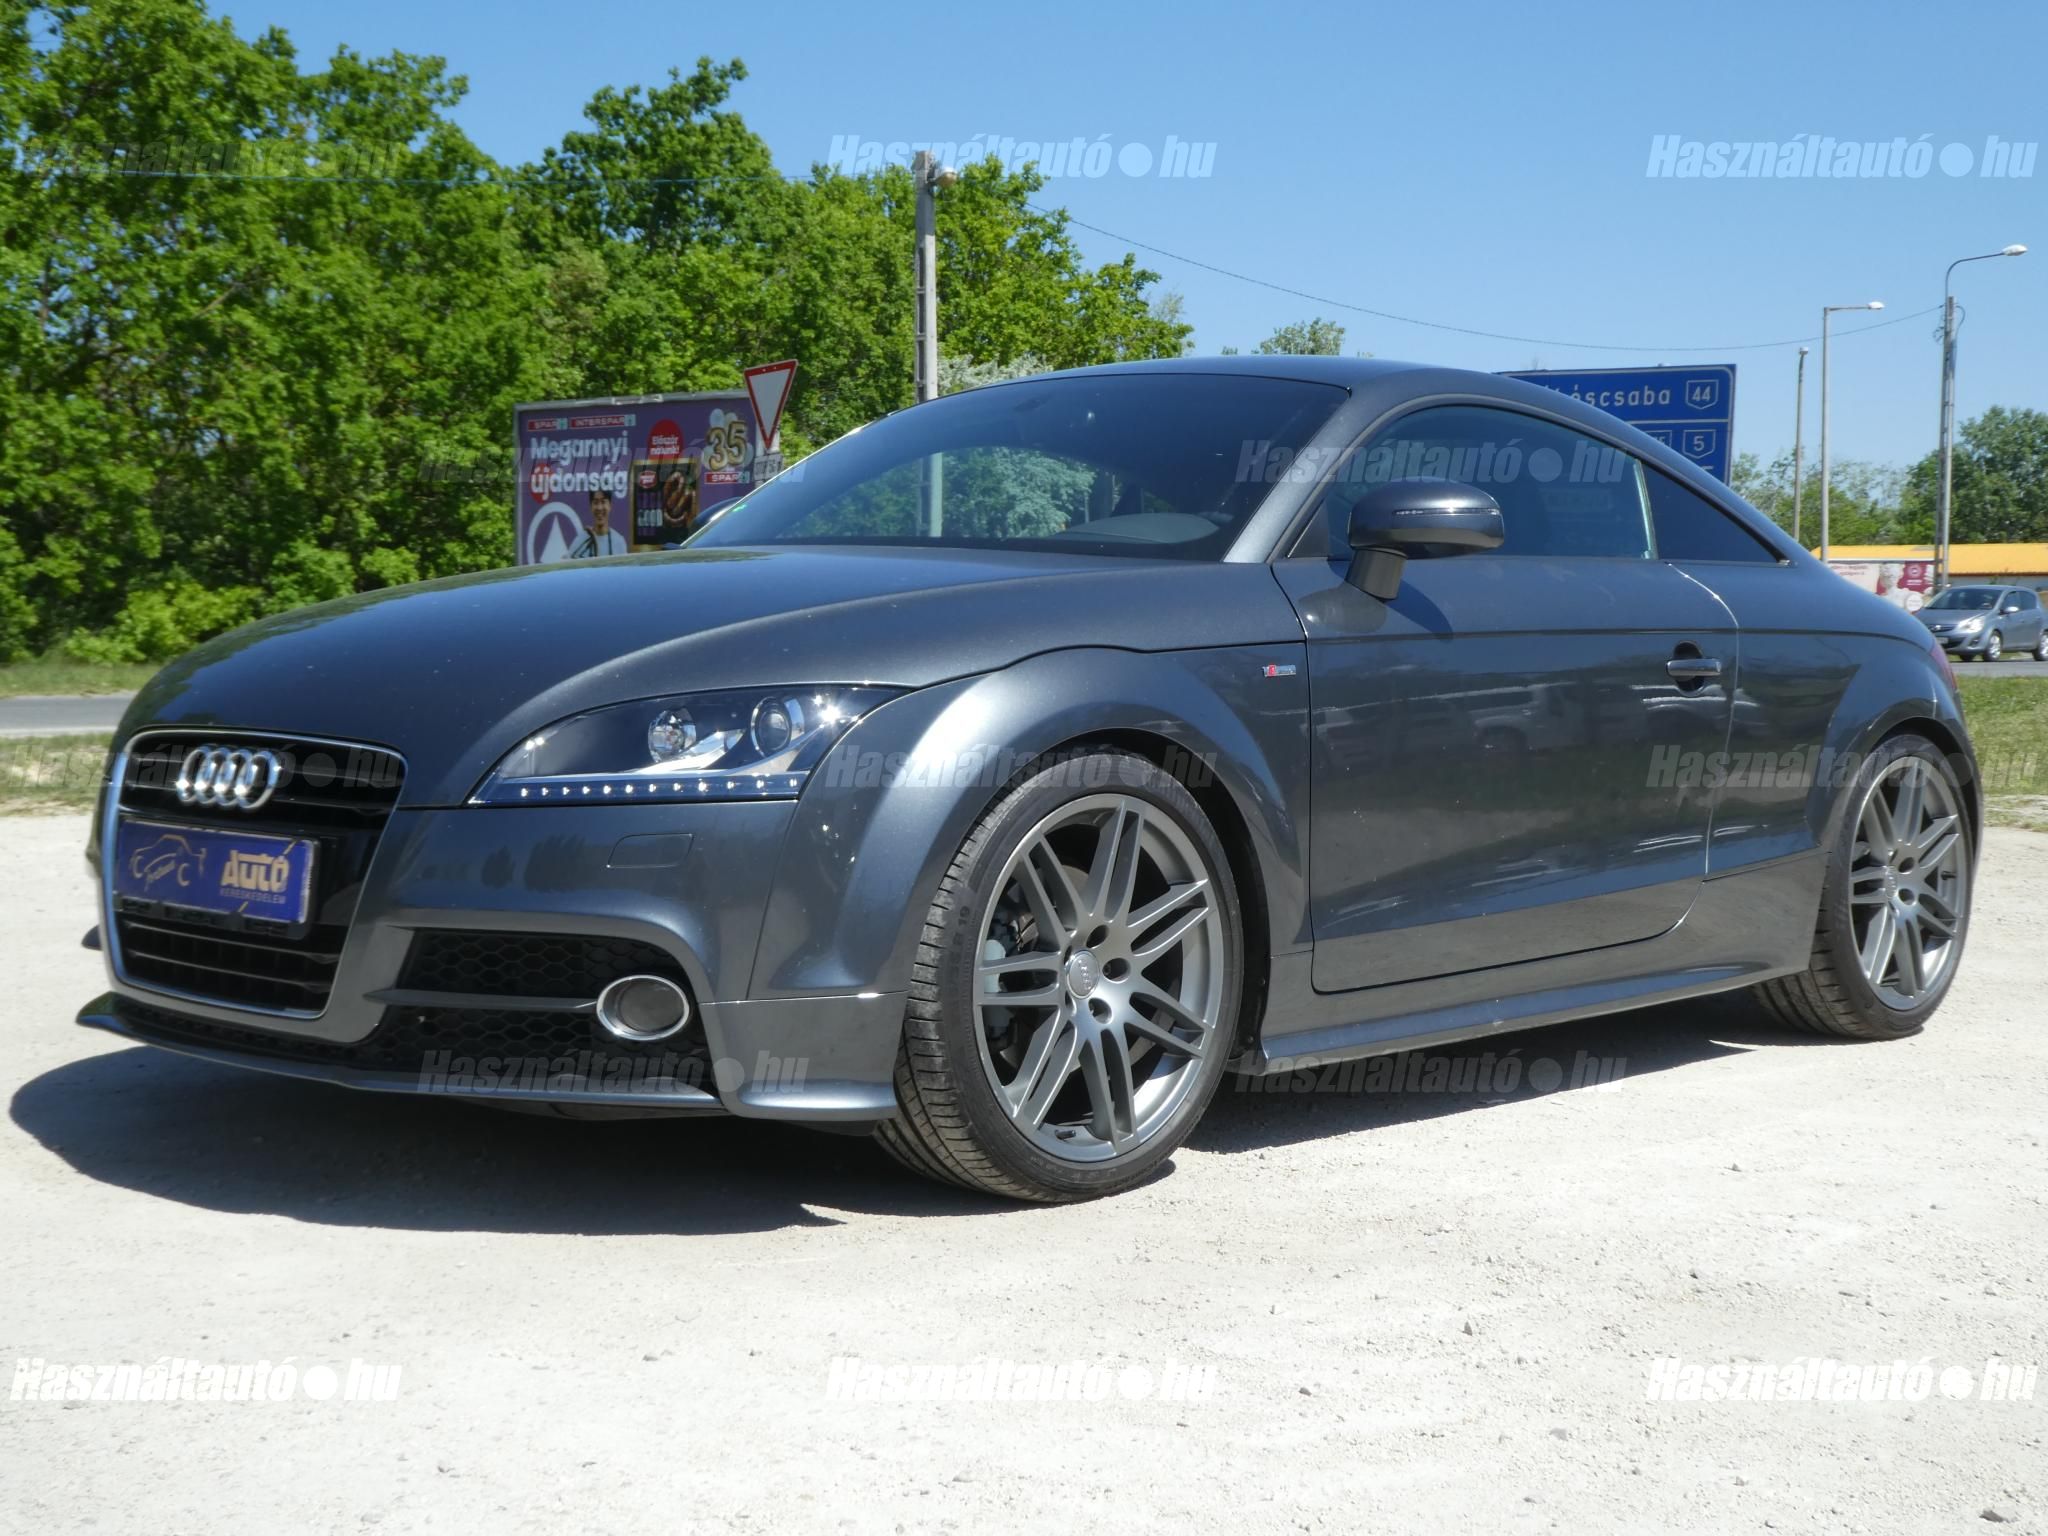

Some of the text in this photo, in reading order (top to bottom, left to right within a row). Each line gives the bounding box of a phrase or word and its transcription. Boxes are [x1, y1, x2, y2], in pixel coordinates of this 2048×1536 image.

[1546, 384, 1711, 407] éscsaba 44
[530, 431, 628, 465] Megannyi
[706, 420, 749, 471] 35
[1693, 435, 1705, 452] 5
[530, 465, 628, 500] újdonság
[711, 472, 741, 483] SPAR
